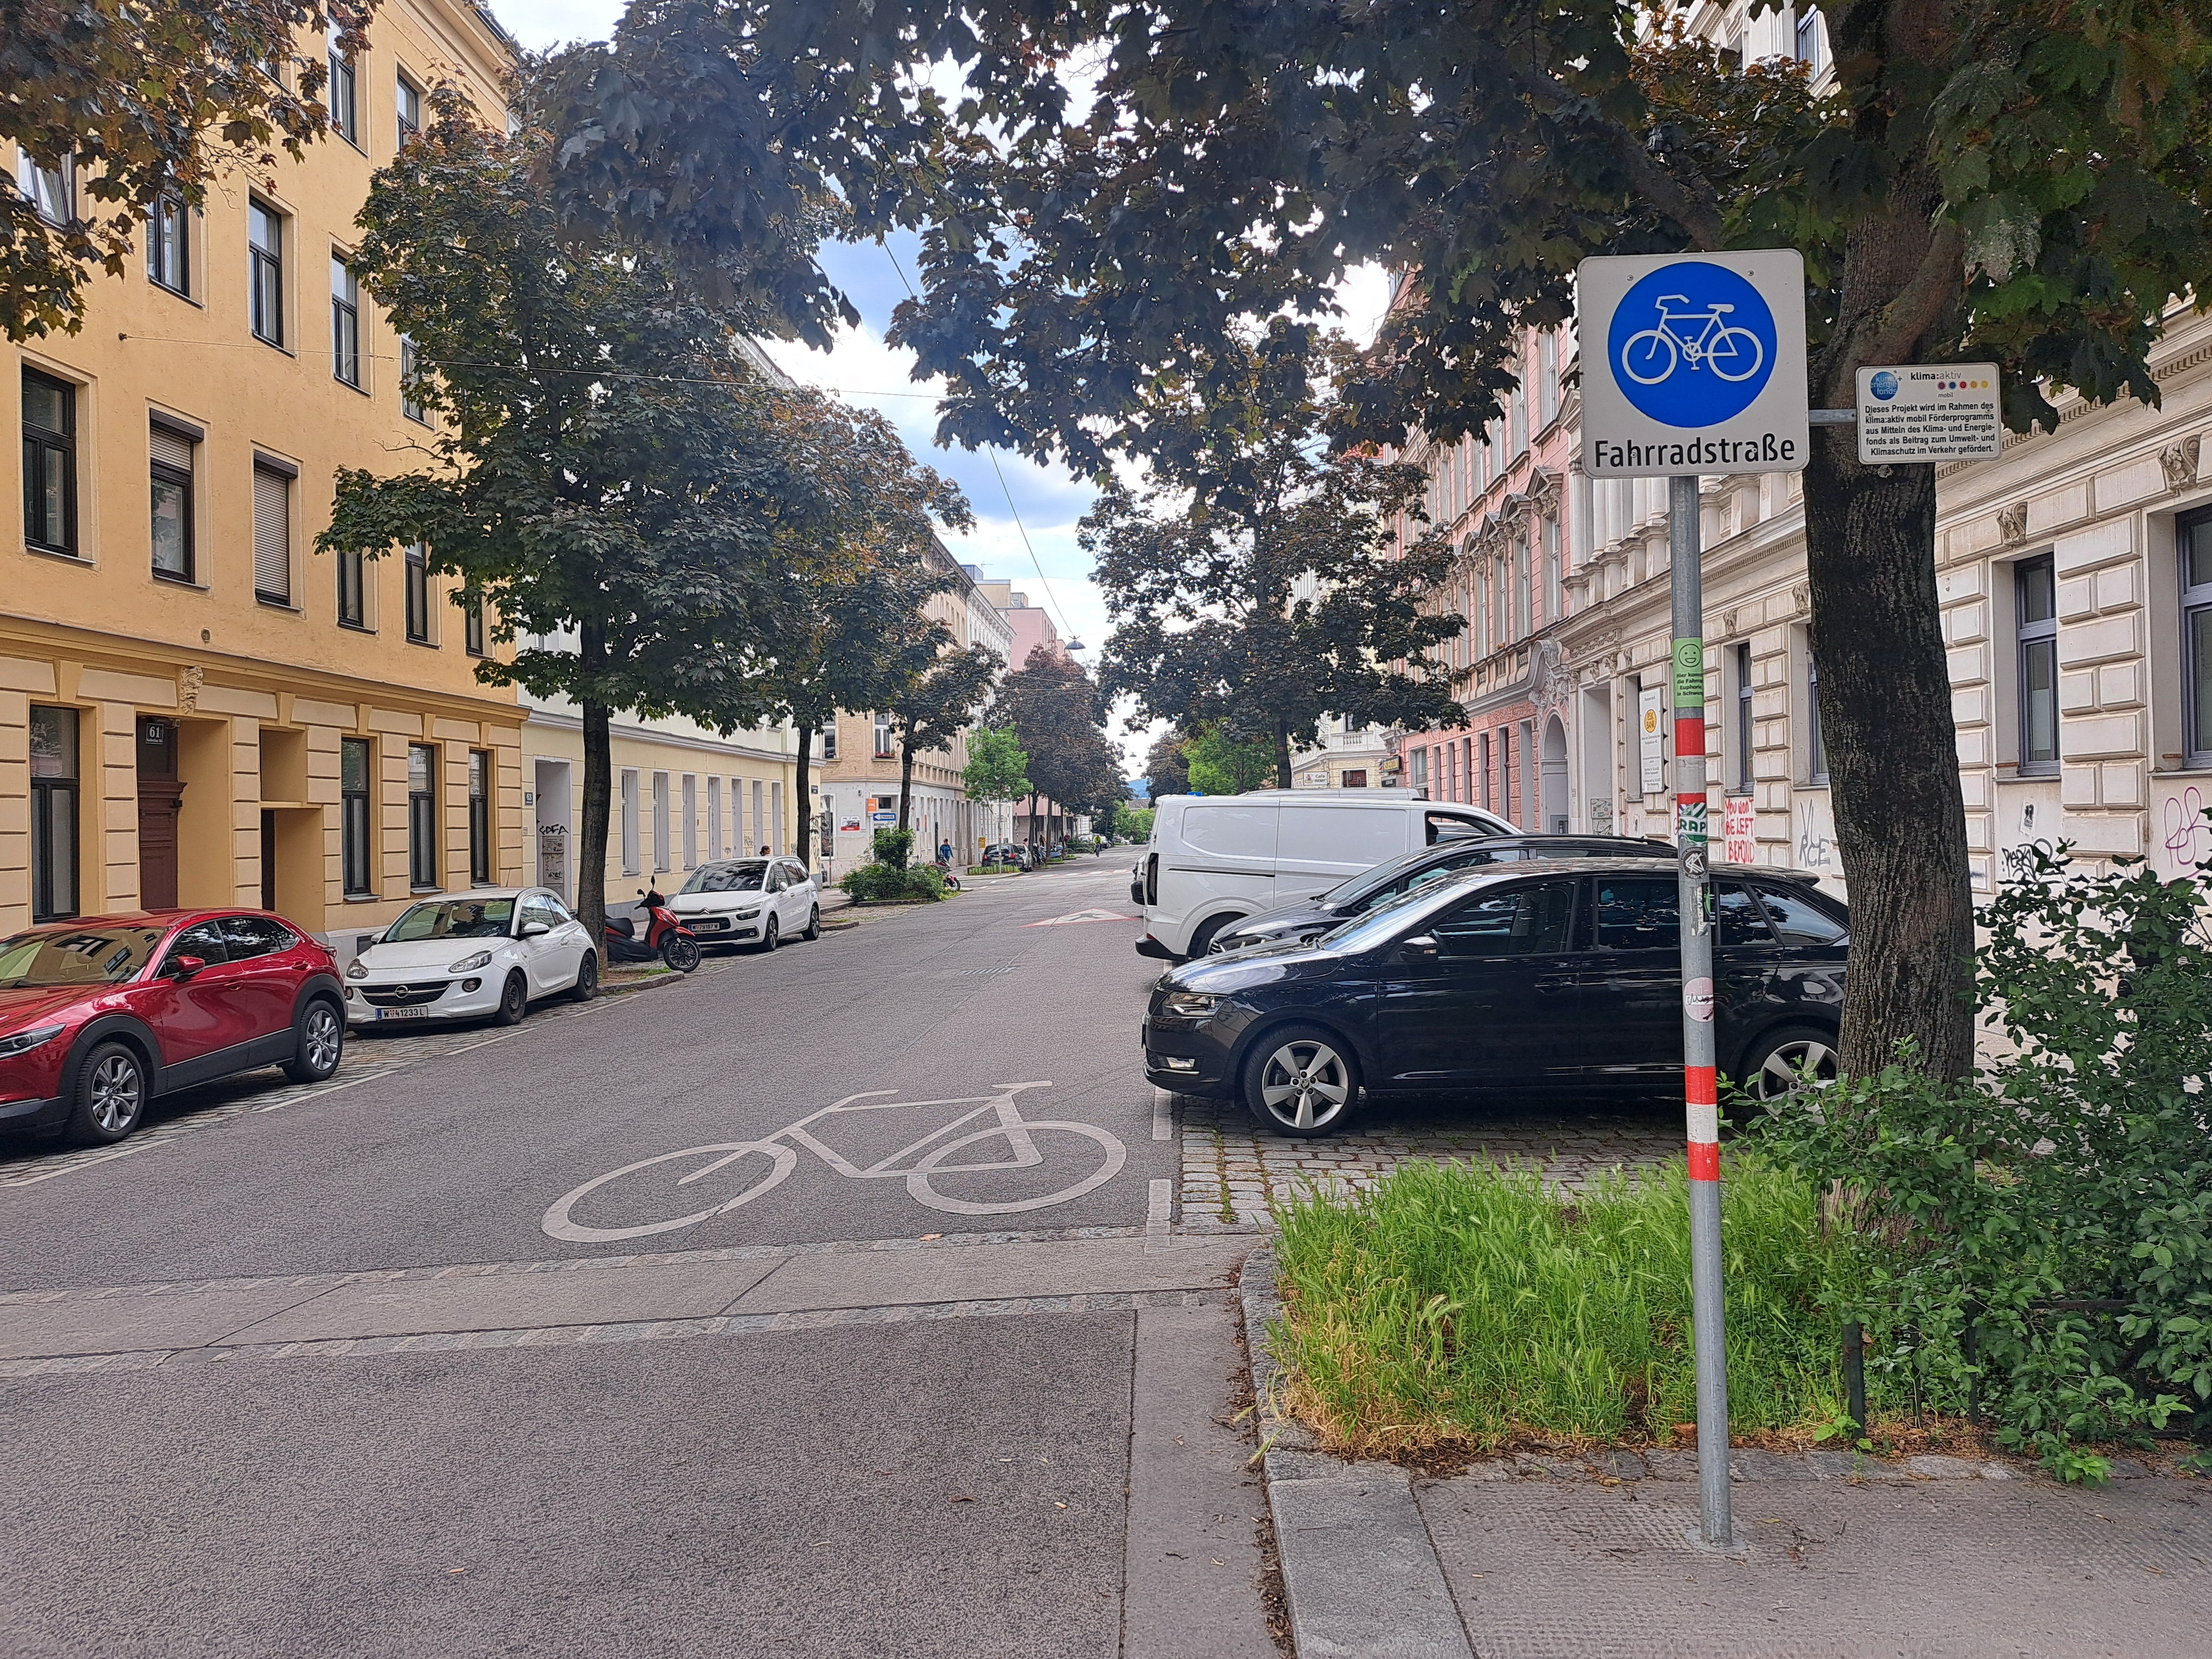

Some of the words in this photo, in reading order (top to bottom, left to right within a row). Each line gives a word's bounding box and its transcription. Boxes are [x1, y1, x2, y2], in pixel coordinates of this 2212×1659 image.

[1911, 370, 1961, 380] klima:aktiv
[1865, 405, 1889, 413] Dieses
[1892, 404, 1917, 413] Projekt
[1929, 414, 1994, 422] Förderprogramms
[1965, 422, 1995, 432] Energie-
[1866, 437, 1886, 445] fonds
[1902, 435, 1928, 444] Beitrag
[1594, 433, 1795, 468] Fahrradstraße
[1871, 447, 1915, 455] Klimaschutz
[1958, 445, 1993, 454] gefördert.
[149, 726, 159, 738] 61
[1726, 819, 1735, 836] BE
[1736, 818, 1754, 837] LEFT
[396, 1009, 418, 1017] 41233
